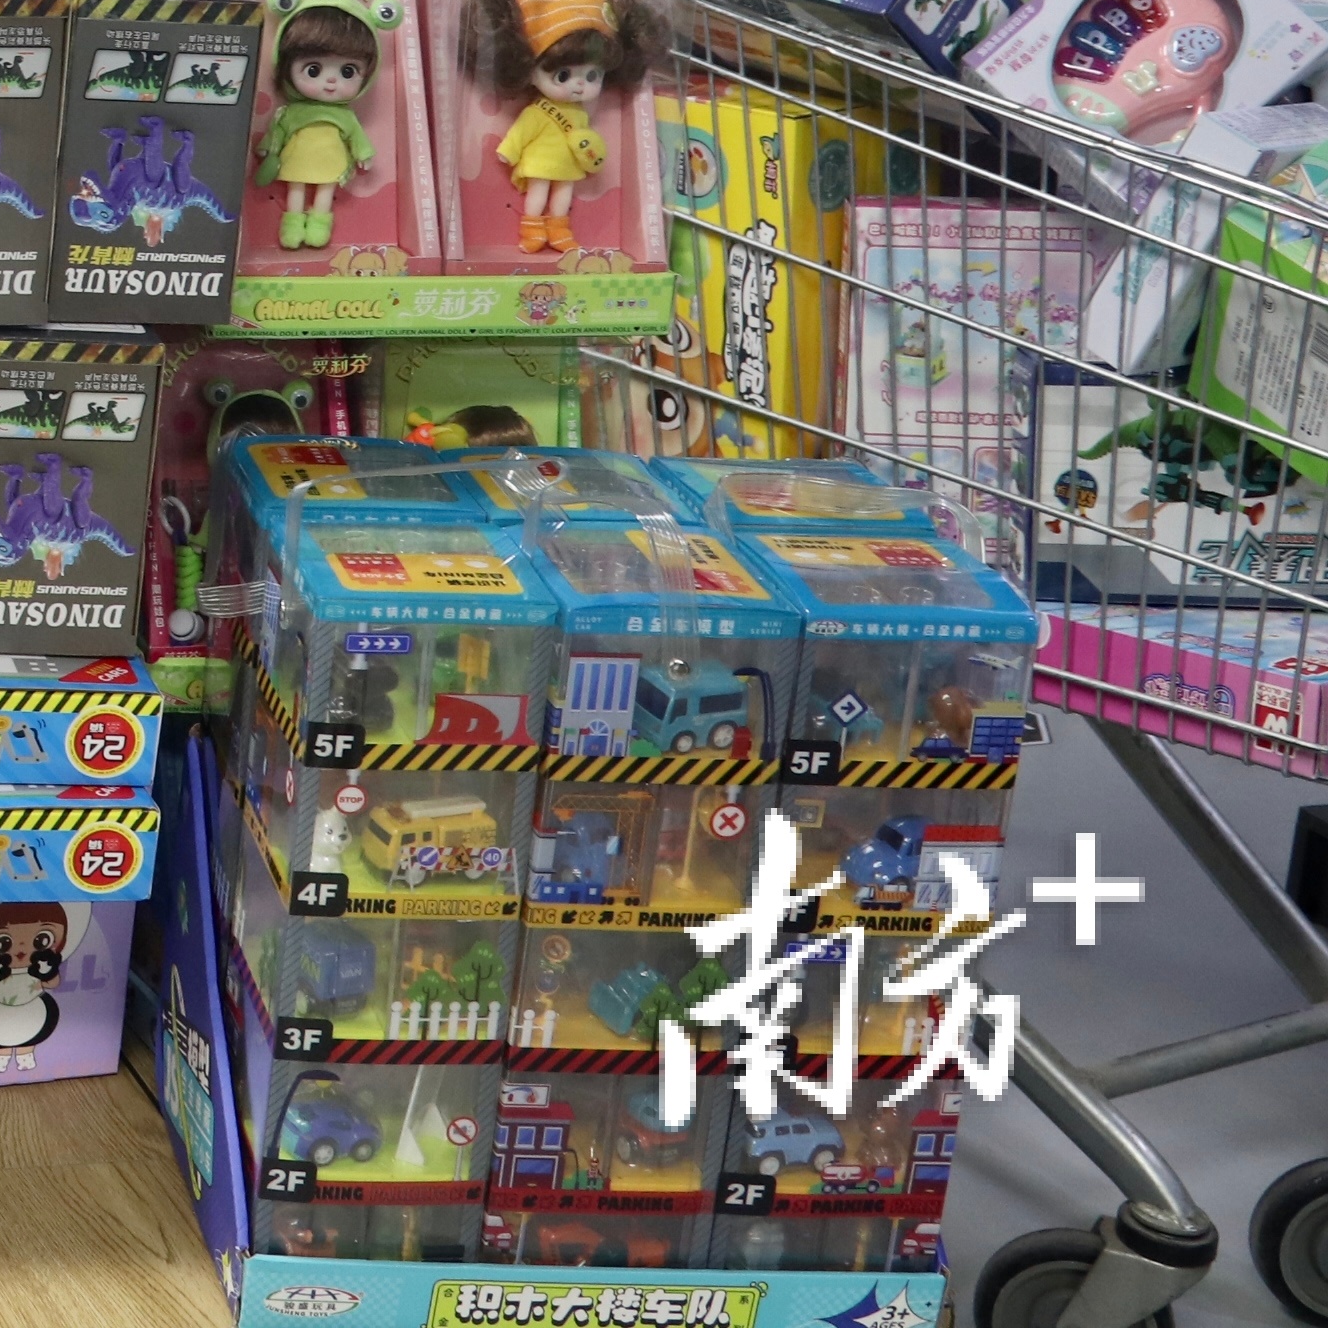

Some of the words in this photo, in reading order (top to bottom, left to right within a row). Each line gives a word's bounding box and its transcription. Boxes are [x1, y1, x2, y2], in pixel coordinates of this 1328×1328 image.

[135, 252, 227, 265] SPINOSAURUS
[64, 268, 224, 298] DINOSAUR
[334, 298, 385, 319] DOLL
[399, 287, 501, 319] 萝莉芬
[215, 329, 245, 337] LOLIFEN
[246, 329, 274, 337] ANIMAL
[275, 329, 300, 337] DOLL
[385, 328, 414, 336] LOLIFEN
[415, 328, 443, 336] ANIMAL
[445, 328, 468, 336] DOLL
[504, 327, 541, 335] FAVORITE
[551, 326, 581, 334] LOLIFEN
[583, 326, 610, 334] ANIMAL
[36, 585, 129, 598] SPINOSAURUS
[97, 666, 129, 682] CARS
[82, 734, 126, 762] 24
[314, 734, 355, 758] 5F
[790, 751, 831, 774] 5F
[338, 795, 364, 805] STOP
[81, 851, 126, 878] 24
[484, 851, 501, 862] 40
[297, 882, 338, 906] 4F
[401, 899, 482, 916] PARKING
[638, 912, 716, 928] PARKING
[854, 915, 933, 932] PARKING
[281, 1028, 322, 1052] 3F
[266, 1170, 307, 1193] 2F
[725, 1183, 765, 1205] 2F
[597, 1196, 676, 1212] PARKING
[810, 1199, 887, 1214] PARKING
[265, 1303, 306, 1317] JUNSHENG
[283, 1301, 338, 1312] 骏盛玩具
[885, 1304, 911, 1319] 3+
